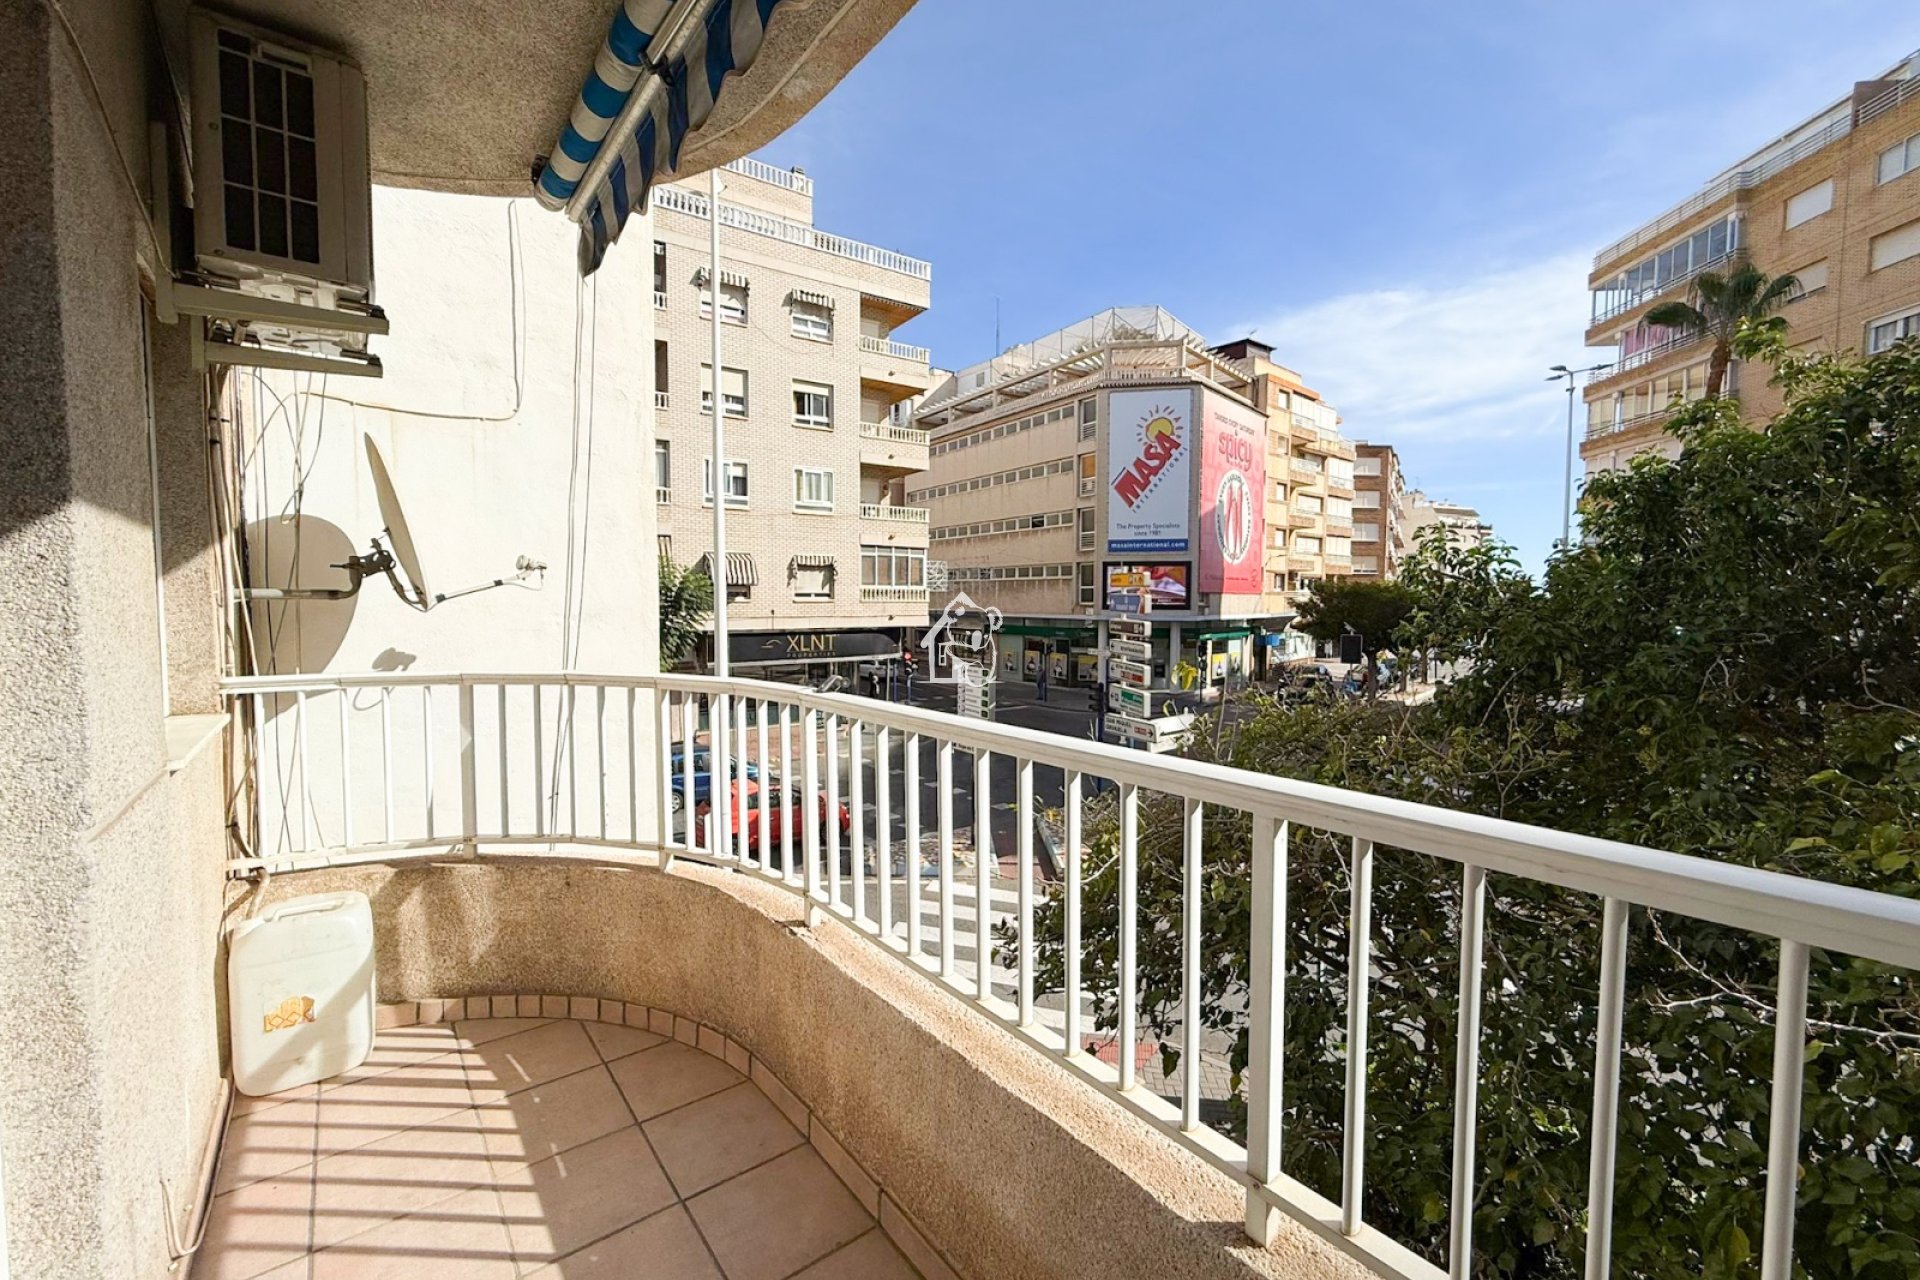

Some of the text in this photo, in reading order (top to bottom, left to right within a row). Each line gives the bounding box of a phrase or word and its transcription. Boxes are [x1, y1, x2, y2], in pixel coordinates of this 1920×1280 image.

[1112, 430, 1182, 509] MASA
[1132, 446, 1188, 514] INTERNATIONAL
[1152, 522, 1181, 530] Specialists
[1110, 541, 1186, 549] masainternational.com
[786, 634, 837, 652] XLNT
